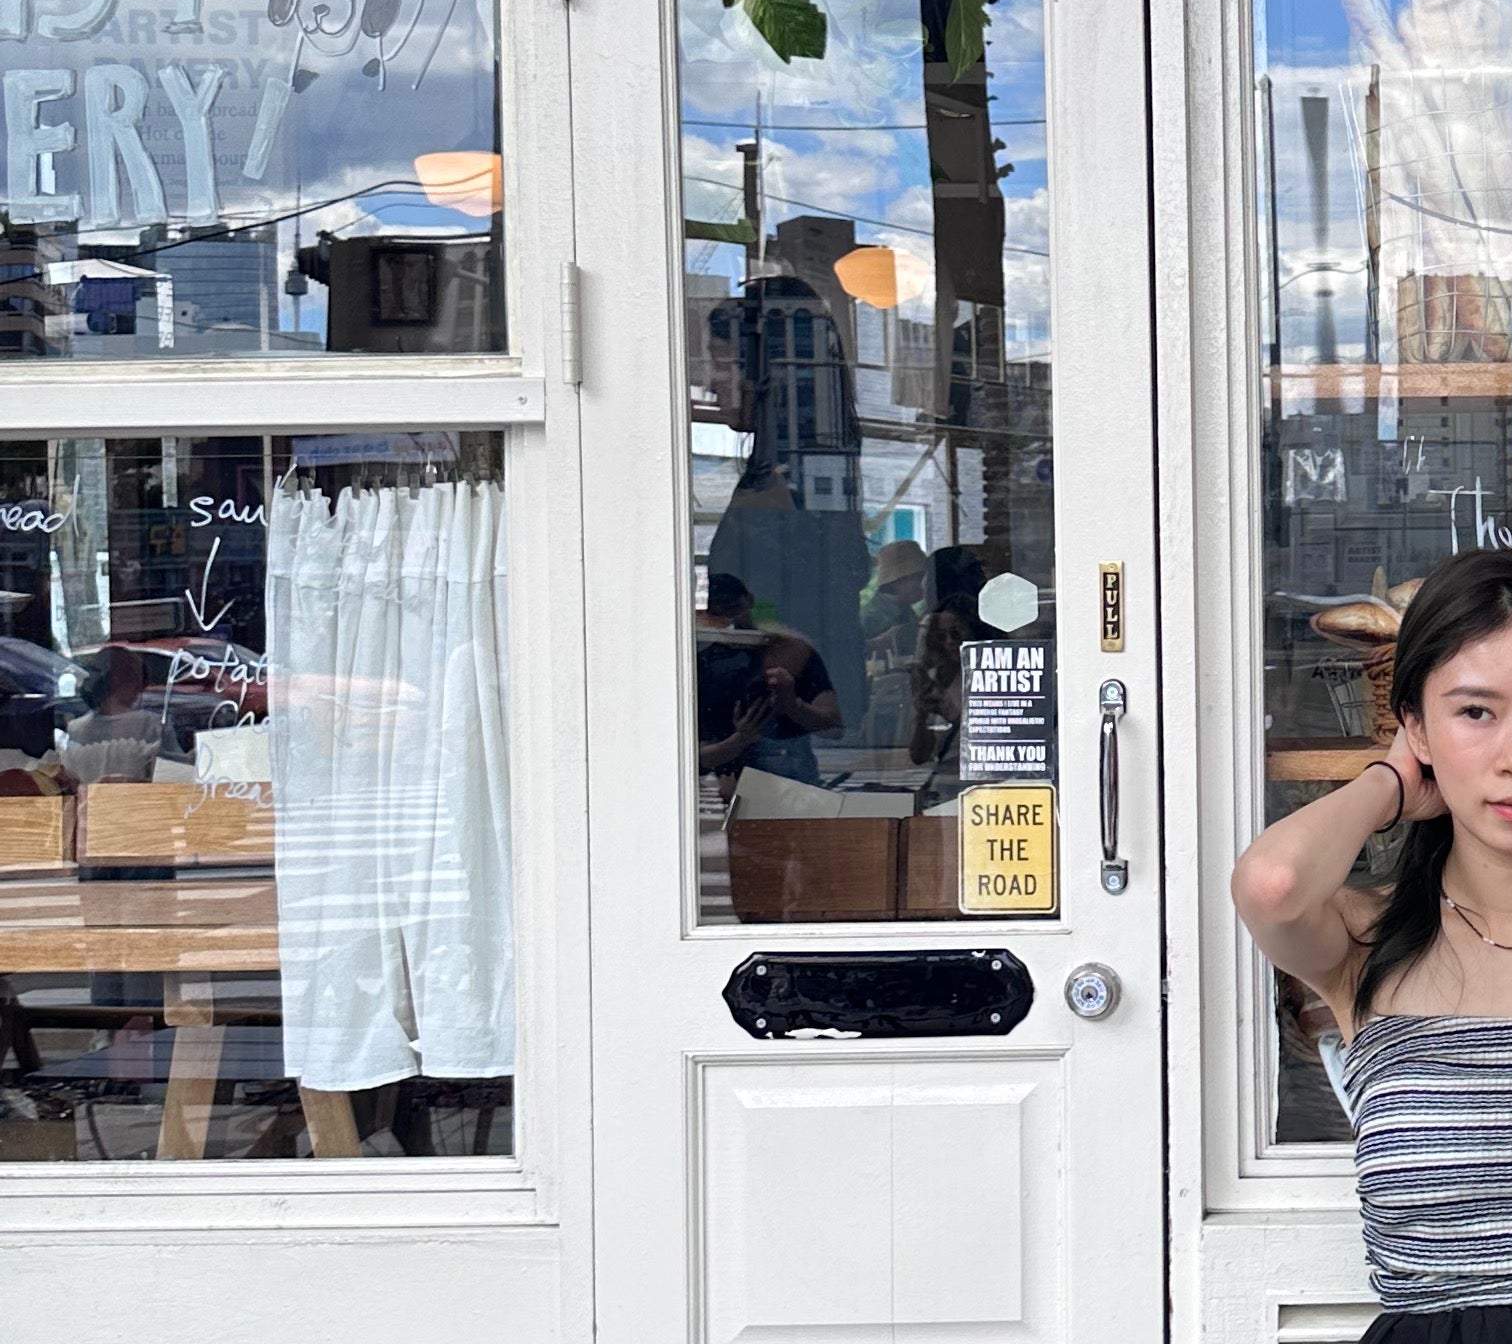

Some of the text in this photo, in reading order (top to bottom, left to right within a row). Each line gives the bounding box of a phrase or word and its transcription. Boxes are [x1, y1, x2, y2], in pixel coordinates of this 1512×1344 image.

[0, 474, 80, 538] ead
[969, 647, 1045, 670] I AM AN
[970, 670, 1043, 693] ARTIST
[969, 745, 1046, 762] THANK YOU
[972, 803, 1044, 826] SHARE
[986, 839, 1029, 862] THE
[977, 873, 1037, 896] ROAD
